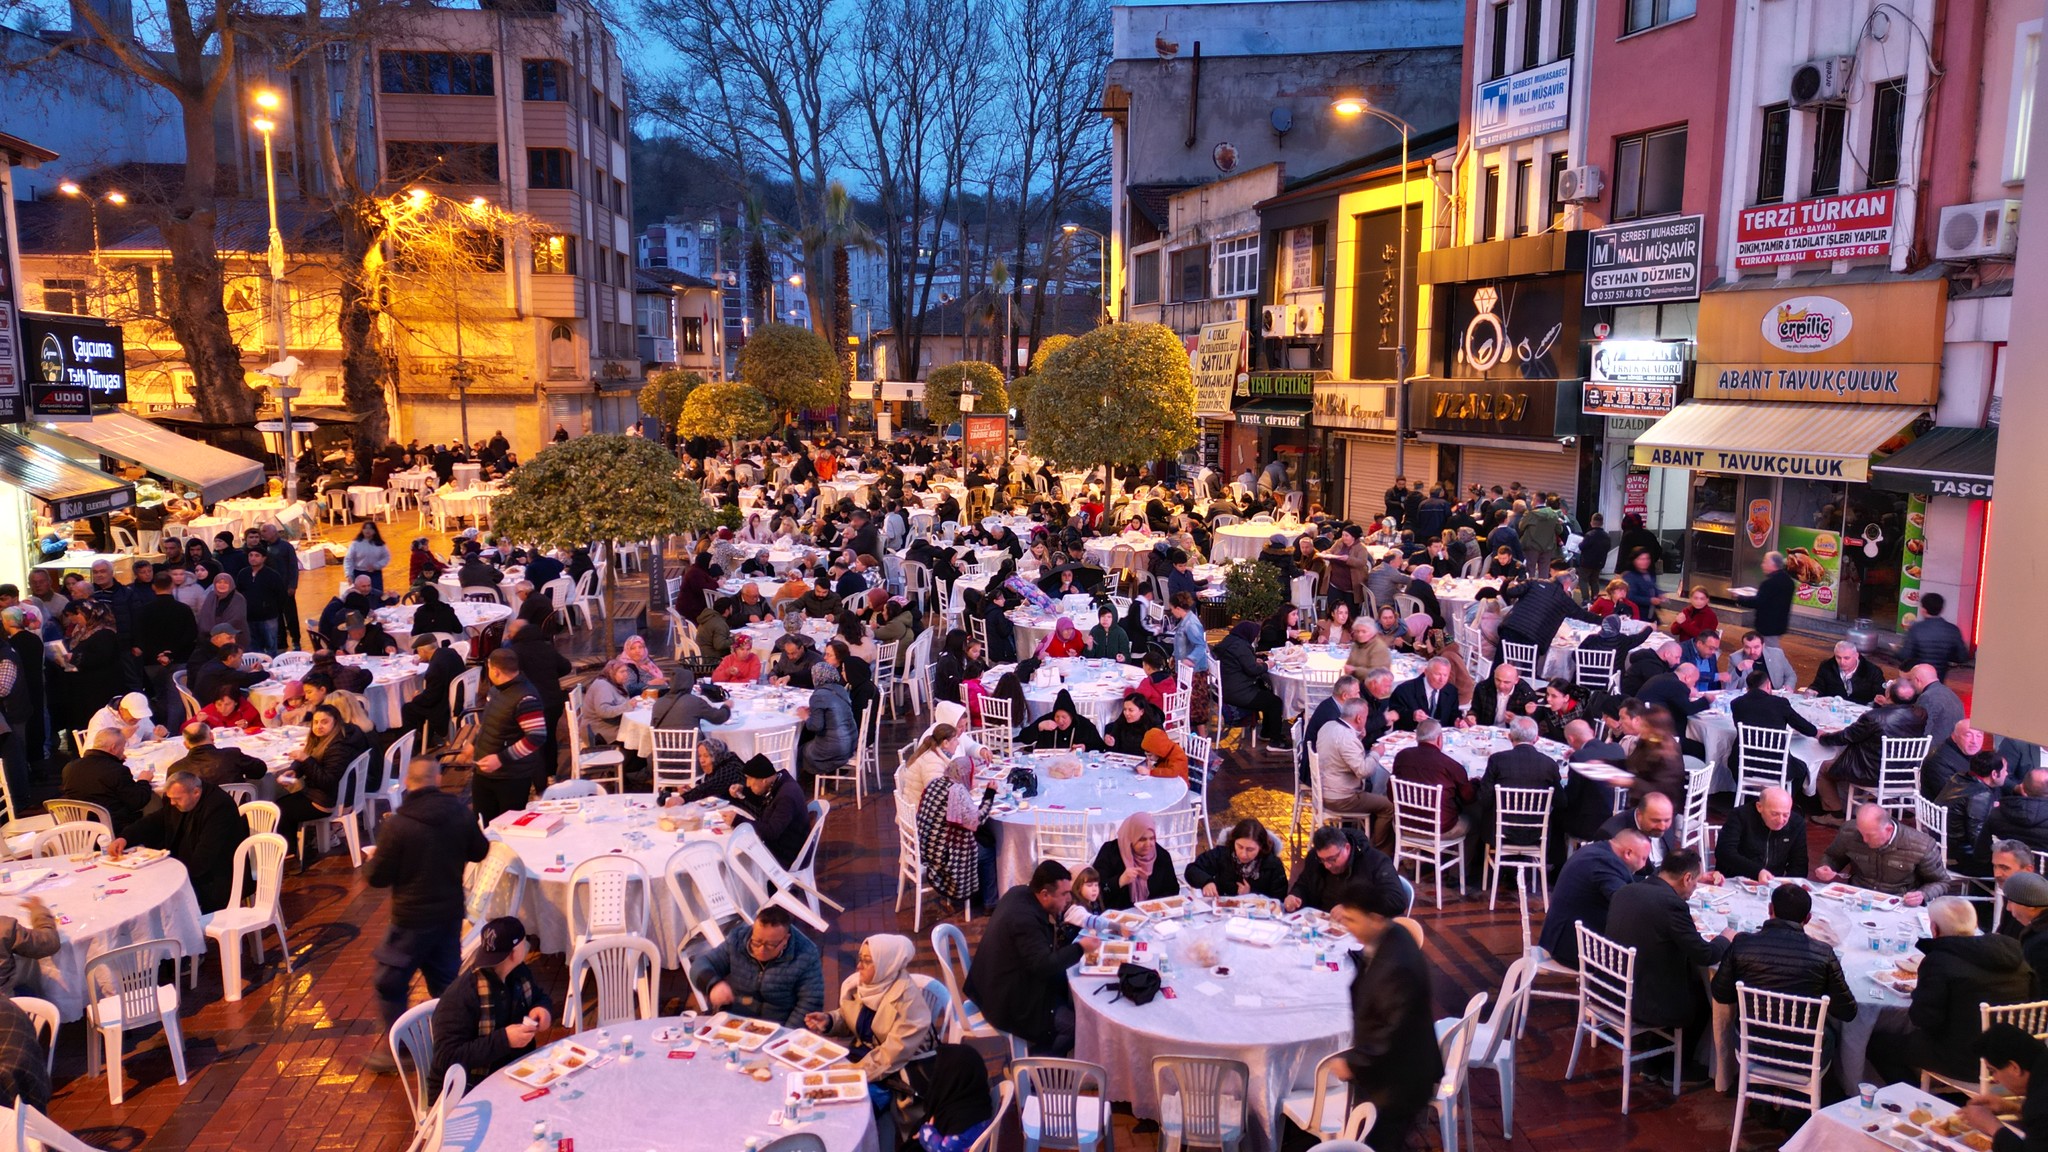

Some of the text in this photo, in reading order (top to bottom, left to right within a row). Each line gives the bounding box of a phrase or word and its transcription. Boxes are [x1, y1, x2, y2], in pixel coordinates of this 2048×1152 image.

[1512, 76, 1533, 90] SERBEST
[1512, 81, 1565, 106] MALİ MÜŞAVİR
[1801, 195, 1886, 224] TÜRKAN
[1620, 222, 1696, 243] SERBEST MUHASEBECİ
[1784, 239, 1790, 250] &
[1826, 231, 1853, 247] İŞLERİ
[1854, 229, 1888, 243] YAPILIR
[1617, 237, 1696, 264] MALİ MÜŞAVİR
[1774, 251, 1806, 264] AKBAŞLI
[1839, 247, 1855, 257] 863
[1856, 246, 1867, 255] 41
[1868, 244, 1880, 255] 66
[1594, 267, 1691, 287] SEYHAN DÜZMEN
[1626, 289, 1634, 298] 48
[1779, 316, 1830, 340] erpiliç
[72, 335, 114, 363] Çaycuma
[1201, 352, 1233, 372] SATILIK
[86, 368, 121, 394] Dünyası
[1251, 372, 1313, 396] YEŞİL ÇİFTLİĞİ
[1718, 369, 1900, 396] ABANT TAVUKÇULUK
[1433, 392, 1528, 422] UZALDI
[1602, 389, 1672, 407] TERZİ
[1240, 414, 1301, 427] YEŞİL ÇİFTLİĞİ
[1611, 418, 1648, 430] UZALDI
[1651, 448, 1844, 477] ABANT TAVUKÇULUK
